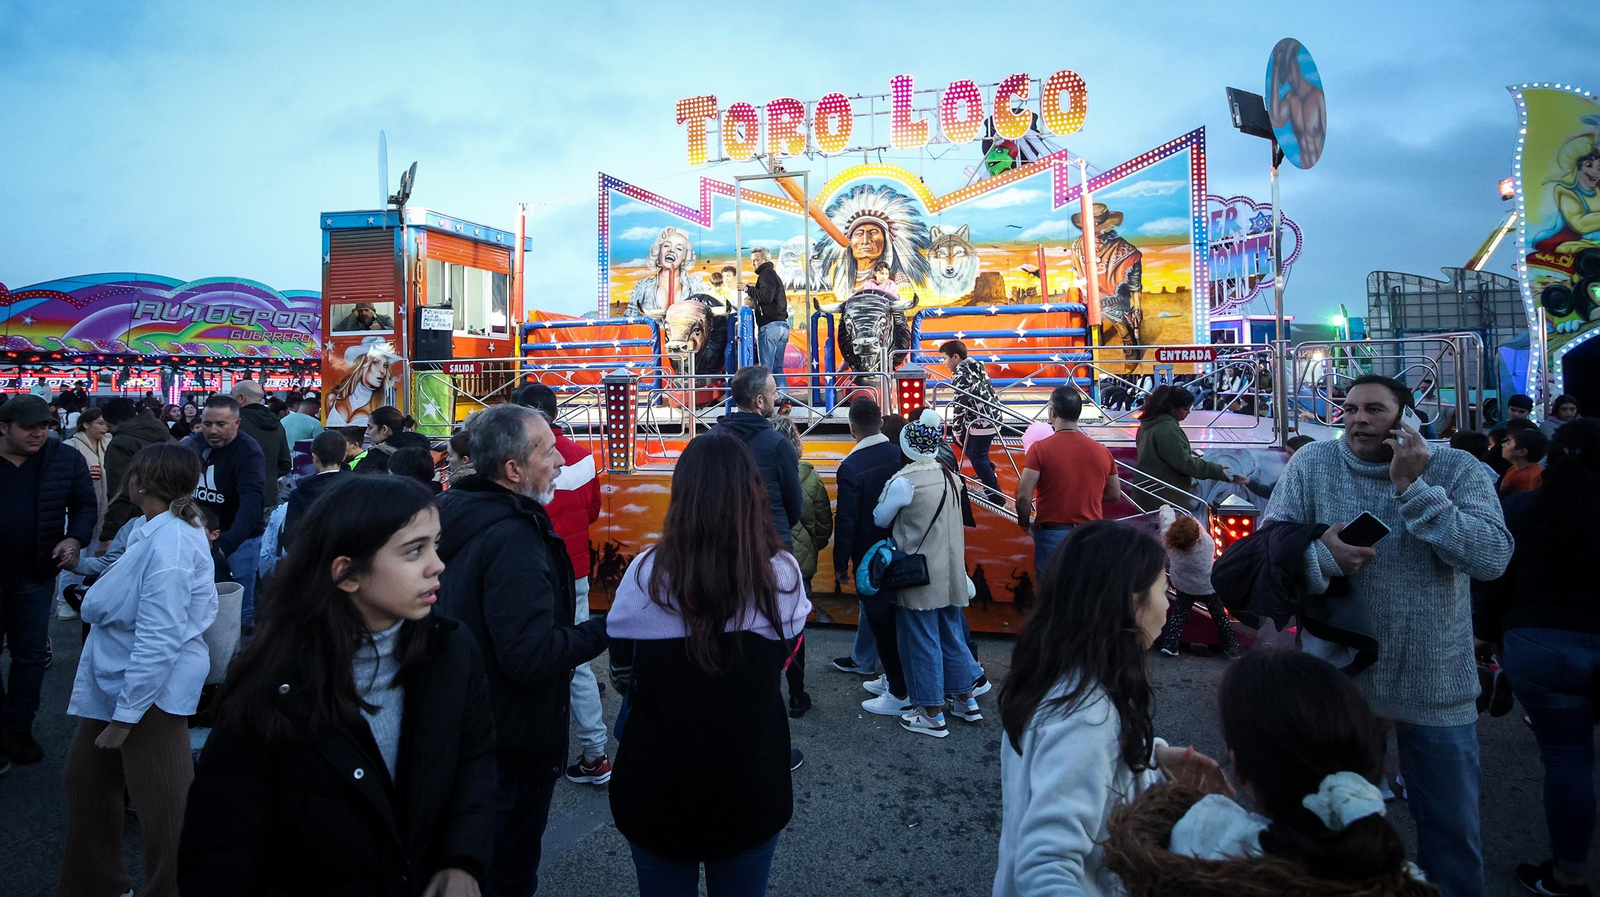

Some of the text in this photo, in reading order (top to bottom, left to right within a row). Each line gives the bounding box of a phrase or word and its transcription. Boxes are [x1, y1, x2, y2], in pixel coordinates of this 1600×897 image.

[675, 68, 1089, 166] TORO LOCO
[230, 329, 312, 345] GUERRERO
[1159, 349, 1212, 361] ENTRADA
[449, 363, 475, 373] SALIDA
[191, 486, 226, 504] idas
